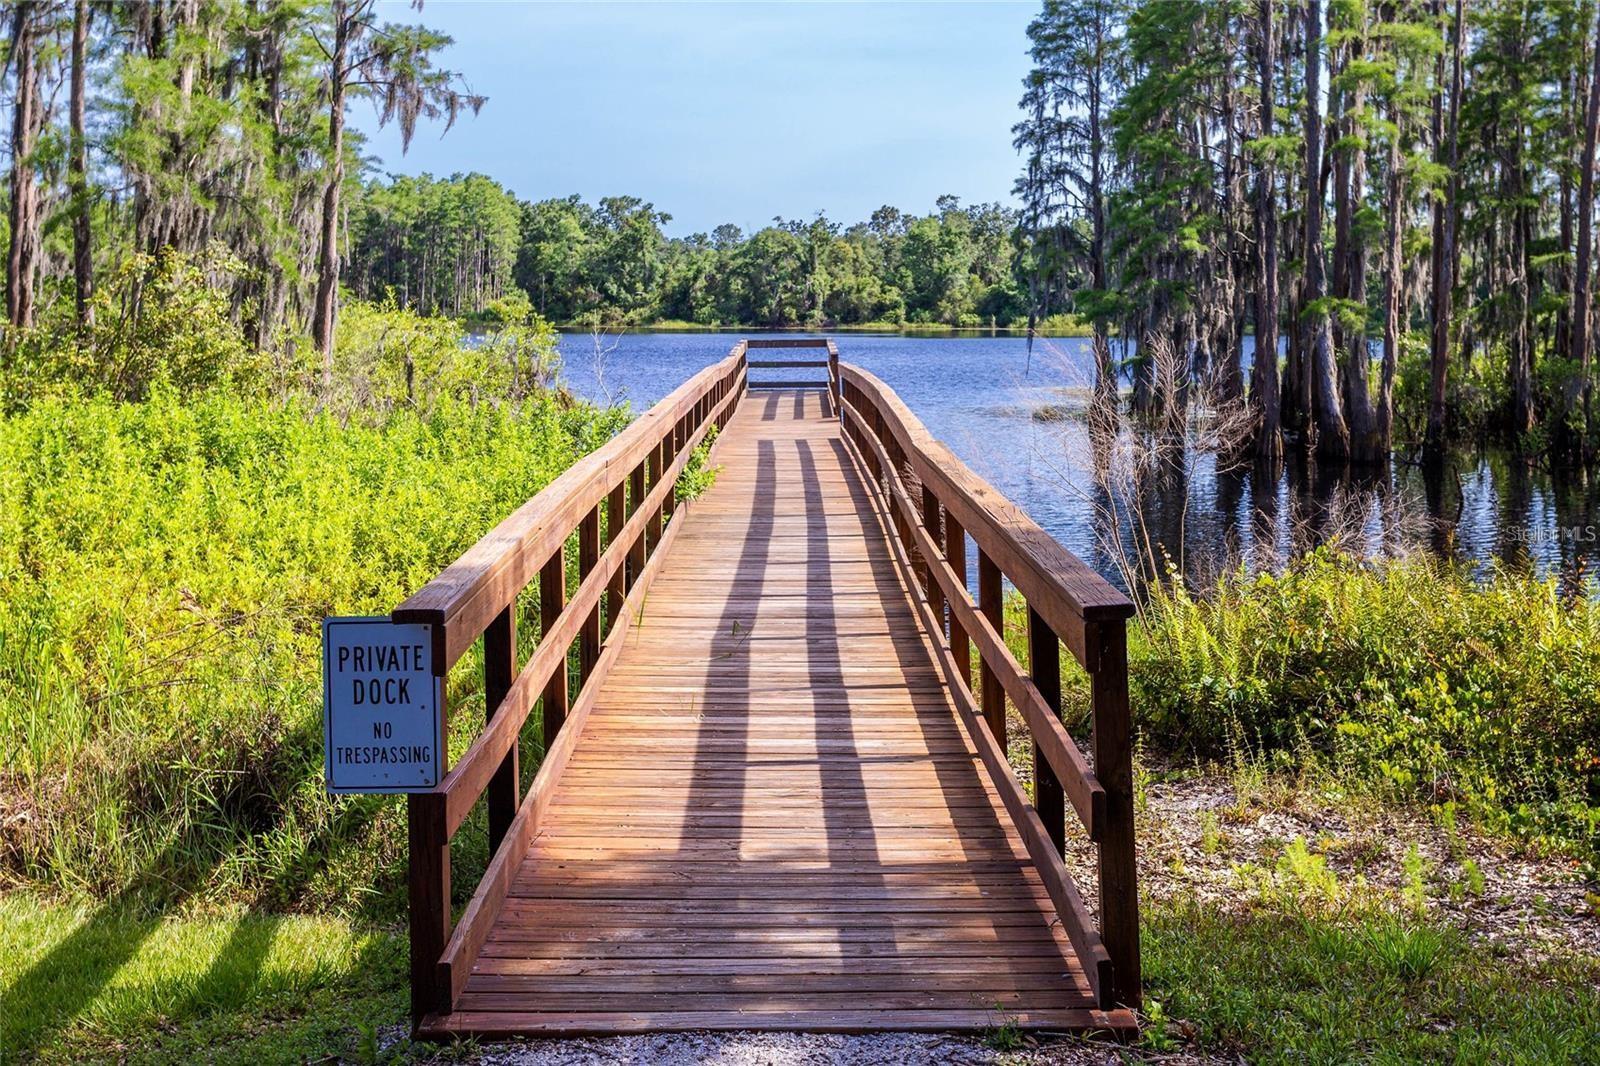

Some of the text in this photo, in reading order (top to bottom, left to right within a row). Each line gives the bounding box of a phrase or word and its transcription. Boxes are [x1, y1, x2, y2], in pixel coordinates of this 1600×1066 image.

[338, 646, 424, 672] PRIVATE
[353, 679, 411, 705] DOCK
[374, 722, 392, 739] NO
[336, 747, 430, 764] TRESPASSING
